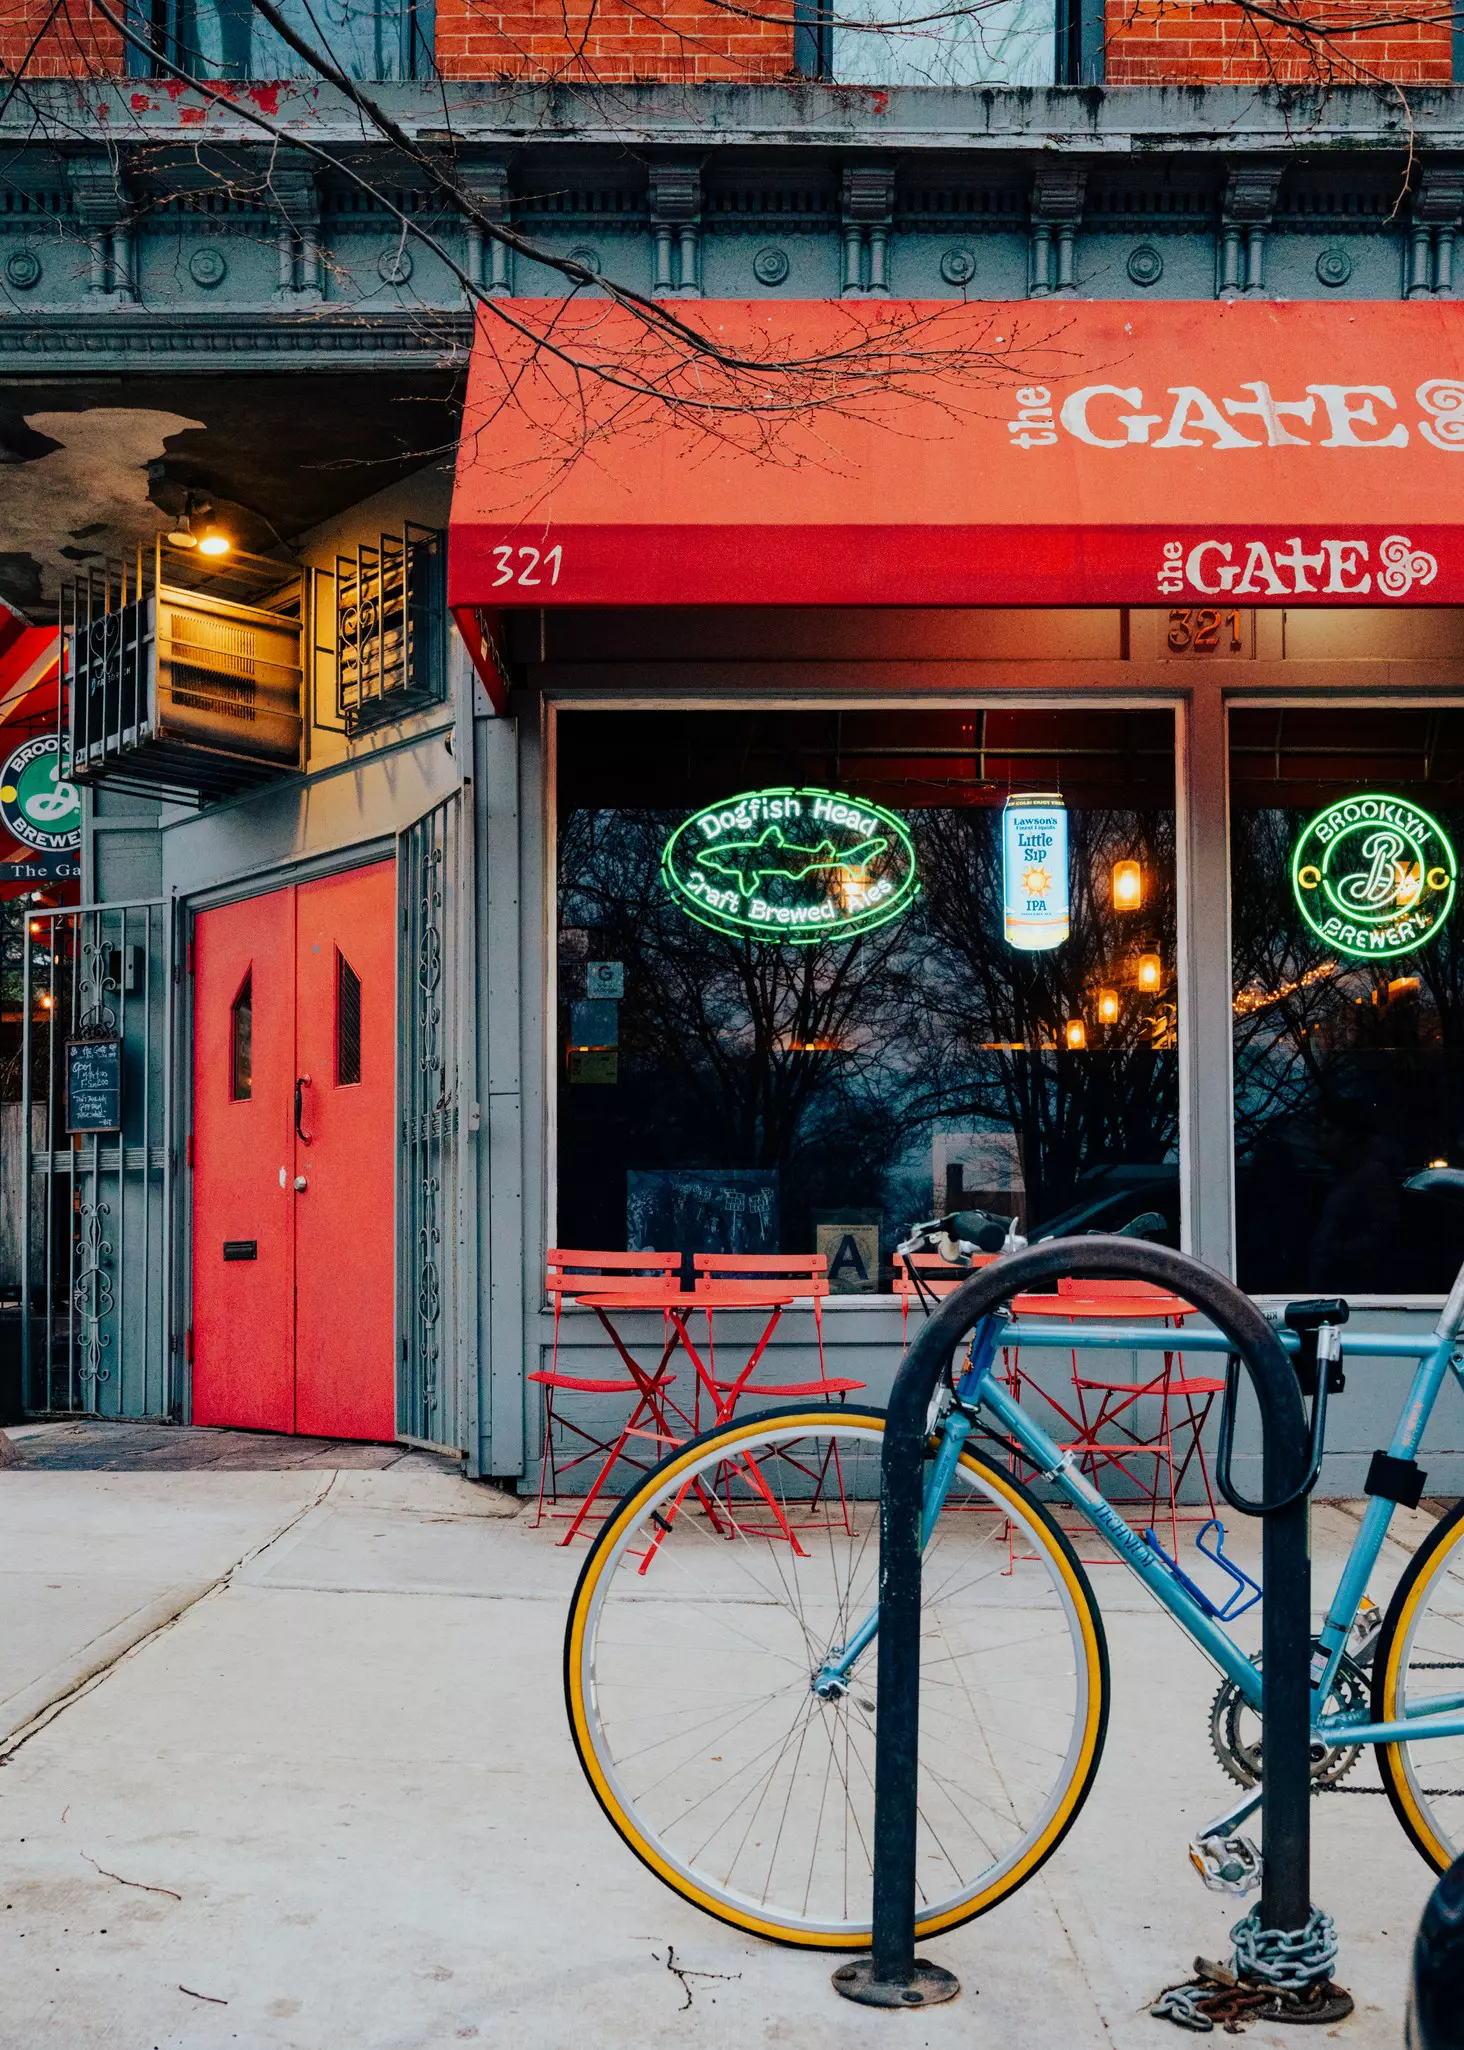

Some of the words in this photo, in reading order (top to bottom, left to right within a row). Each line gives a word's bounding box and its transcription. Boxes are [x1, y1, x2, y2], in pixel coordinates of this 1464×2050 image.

[1007, 385, 1057, 449] the
[1060, 380, 1409, 449] GATE
[491, 545, 562, 587] 321
[1157, 541, 1184, 595] the
[1185, 537, 1371, 594] GATE
[1168, 609, 1242, 650] 321
[12, 816, 81, 848] BREWE
[697, 796, 800, 839] Dogfish
[813, 797, 879, 837] Head
[1014, 816, 1058, 827] Lawson's
[1315, 801, 1433, 845] BROOKLYN
[1018, 831, 1053, 847] Little
[1024, 848, 1047, 863] Sip
[11, 865, 47, 877] The
[55, 864, 80, 876] Ga
[685, 871, 741, 914] Craft
[748, 898, 836, 925] Brewed
[847, 877, 893, 914] Ales
[1026, 900, 1047, 911] IPA
[1320, 912, 1427, 950] BREWERY
[828, 1233, 868, 1280] A
